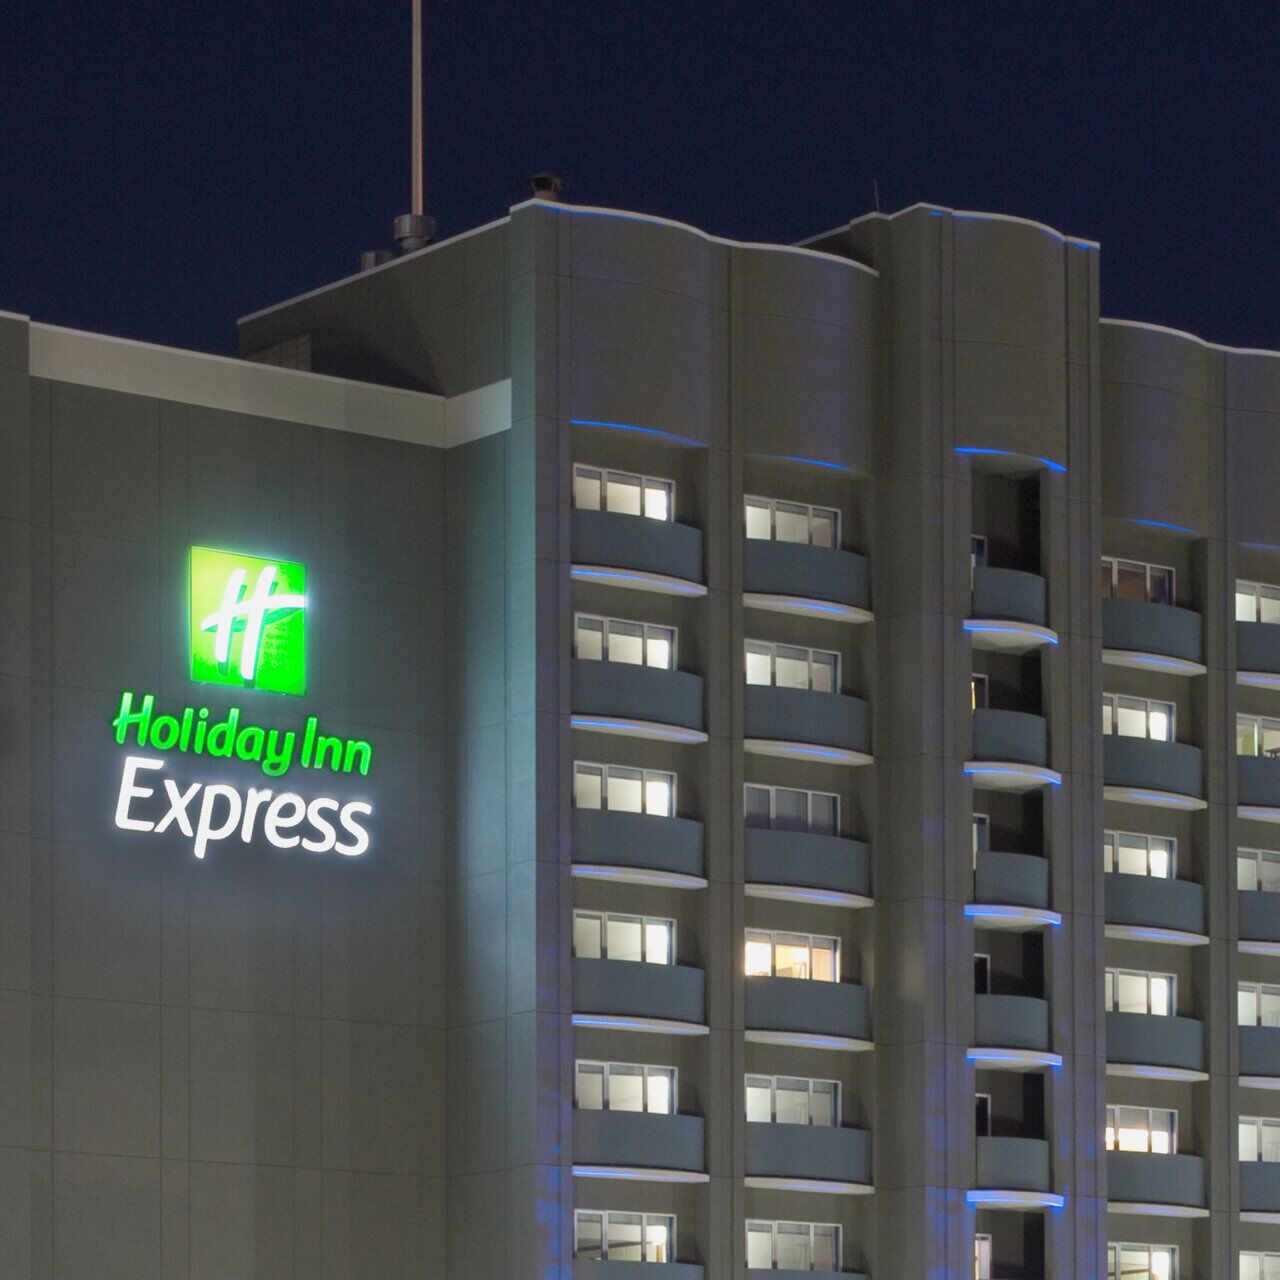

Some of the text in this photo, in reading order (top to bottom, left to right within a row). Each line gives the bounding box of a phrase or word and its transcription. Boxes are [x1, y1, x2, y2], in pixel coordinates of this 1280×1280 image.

[201, 565, 305, 680] H
[113, 691, 372, 777] Holiday Inn
[115, 756, 372, 859] Express
